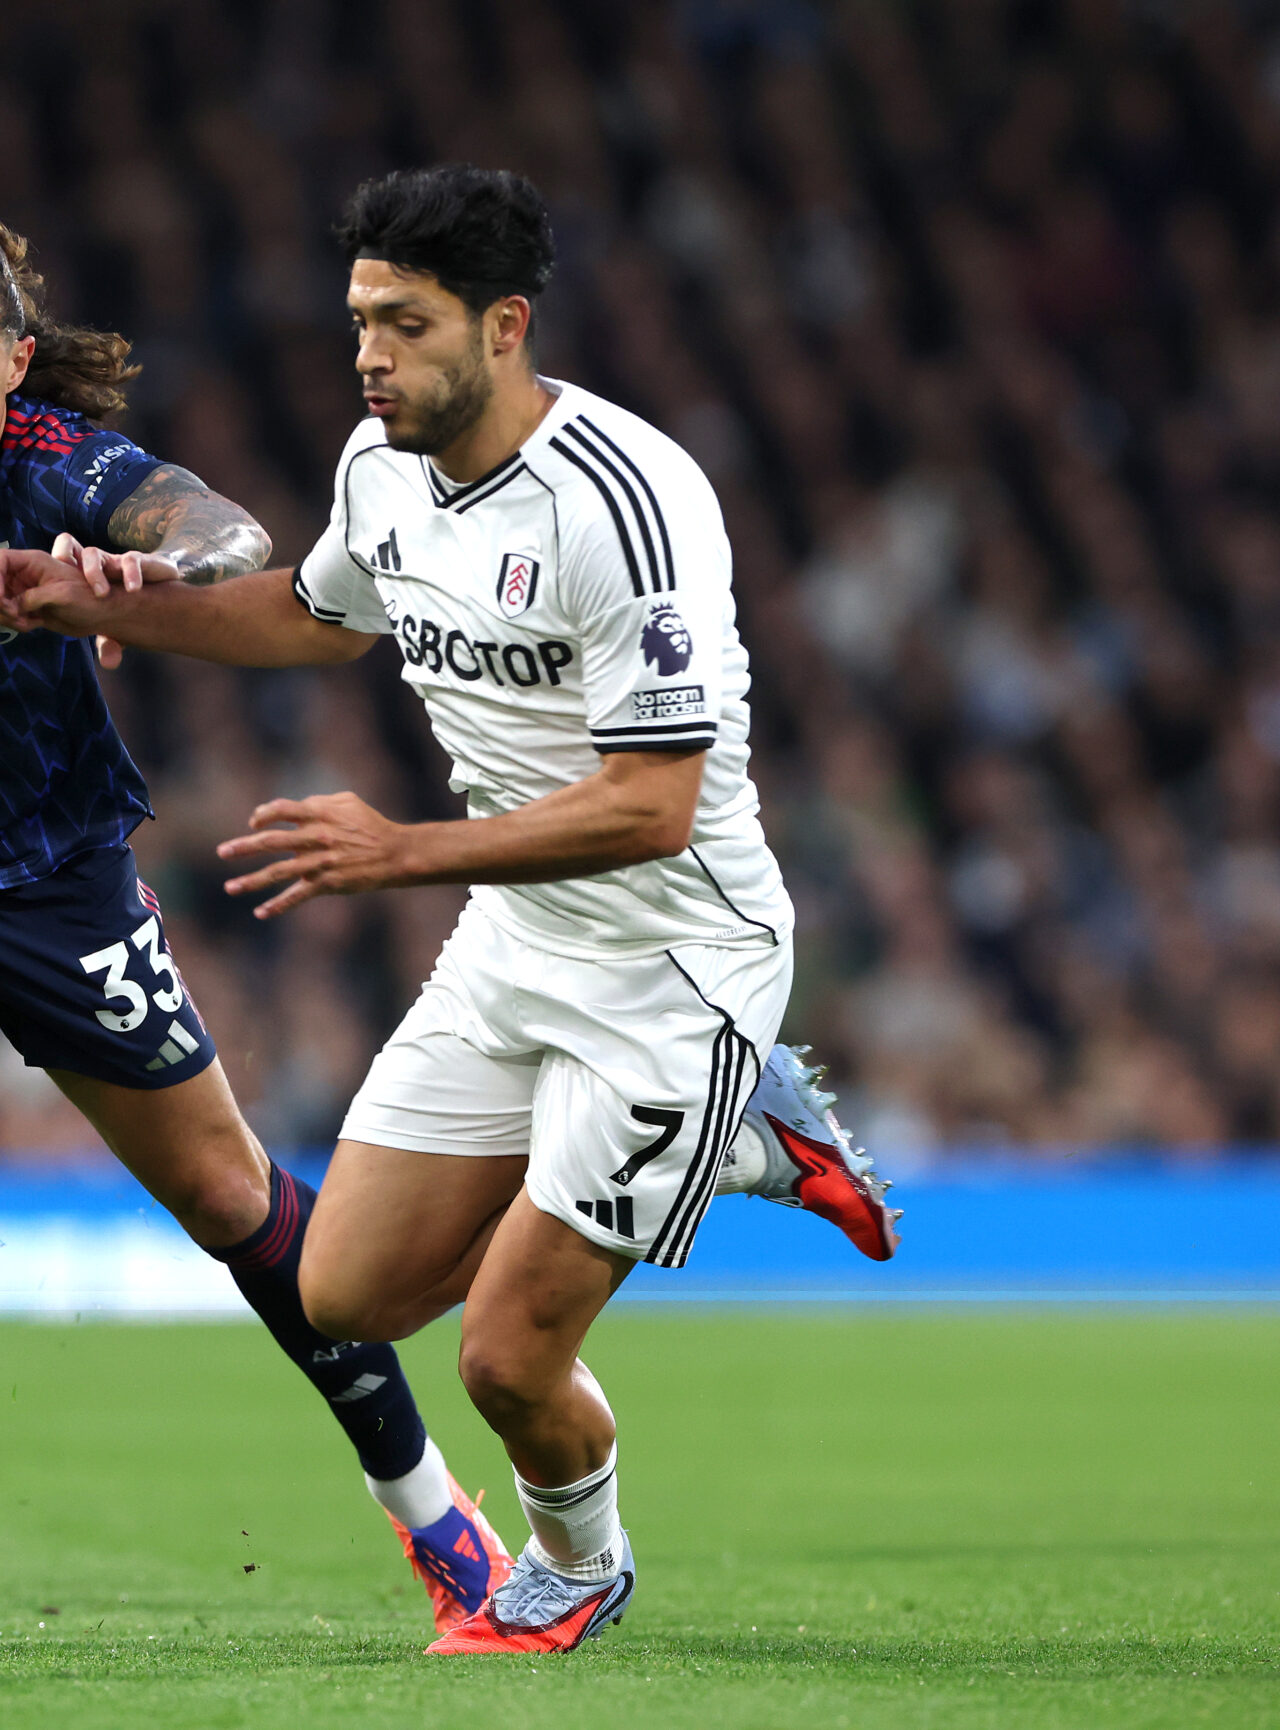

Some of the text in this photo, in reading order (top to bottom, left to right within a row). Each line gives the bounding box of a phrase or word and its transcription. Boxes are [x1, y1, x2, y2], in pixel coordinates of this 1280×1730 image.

[506, 562, 529, 606] FFC
[402, 613, 574, 688] SBOTOP
[631, 687, 701, 707] No room
[78, 914, 183, 1033] 33
[608, 1103, 686, 1187] 7
[313, 1341, 362, 1363] AF
